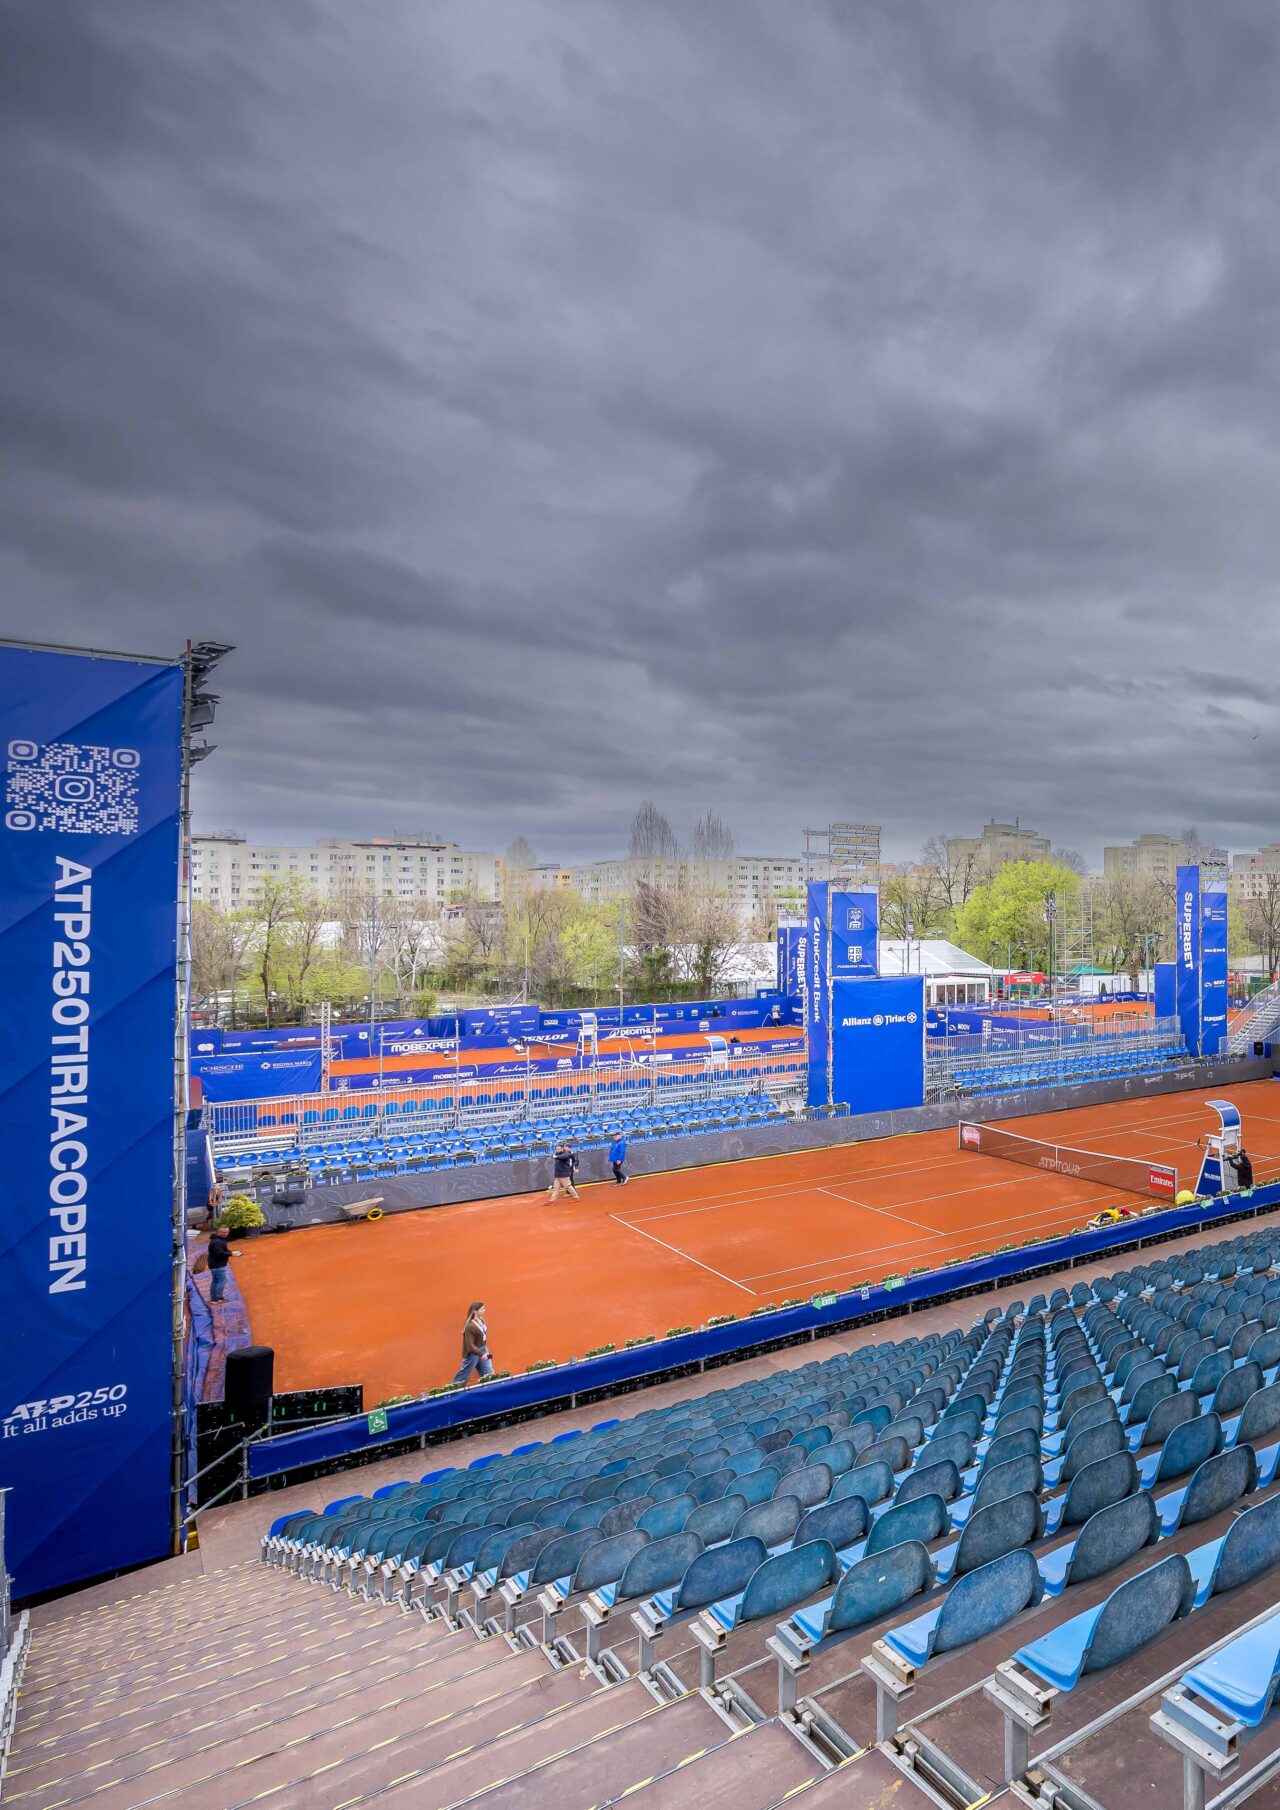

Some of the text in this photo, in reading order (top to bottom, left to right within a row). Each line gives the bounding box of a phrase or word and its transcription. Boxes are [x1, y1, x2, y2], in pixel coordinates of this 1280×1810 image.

[1183, 891, 1194, 970] SUPERBET
[796, 936, 807, 990] SUPERBET
[813, 933, 821, 989] UniCredit
[620, 1026, 663, 1037] DECATHLON
[842, 1017, 872, 1028] Allianz
[1150, 1174, 1174, 1188] Emirates
[2, 1403, 127, 1438] It all adds up
